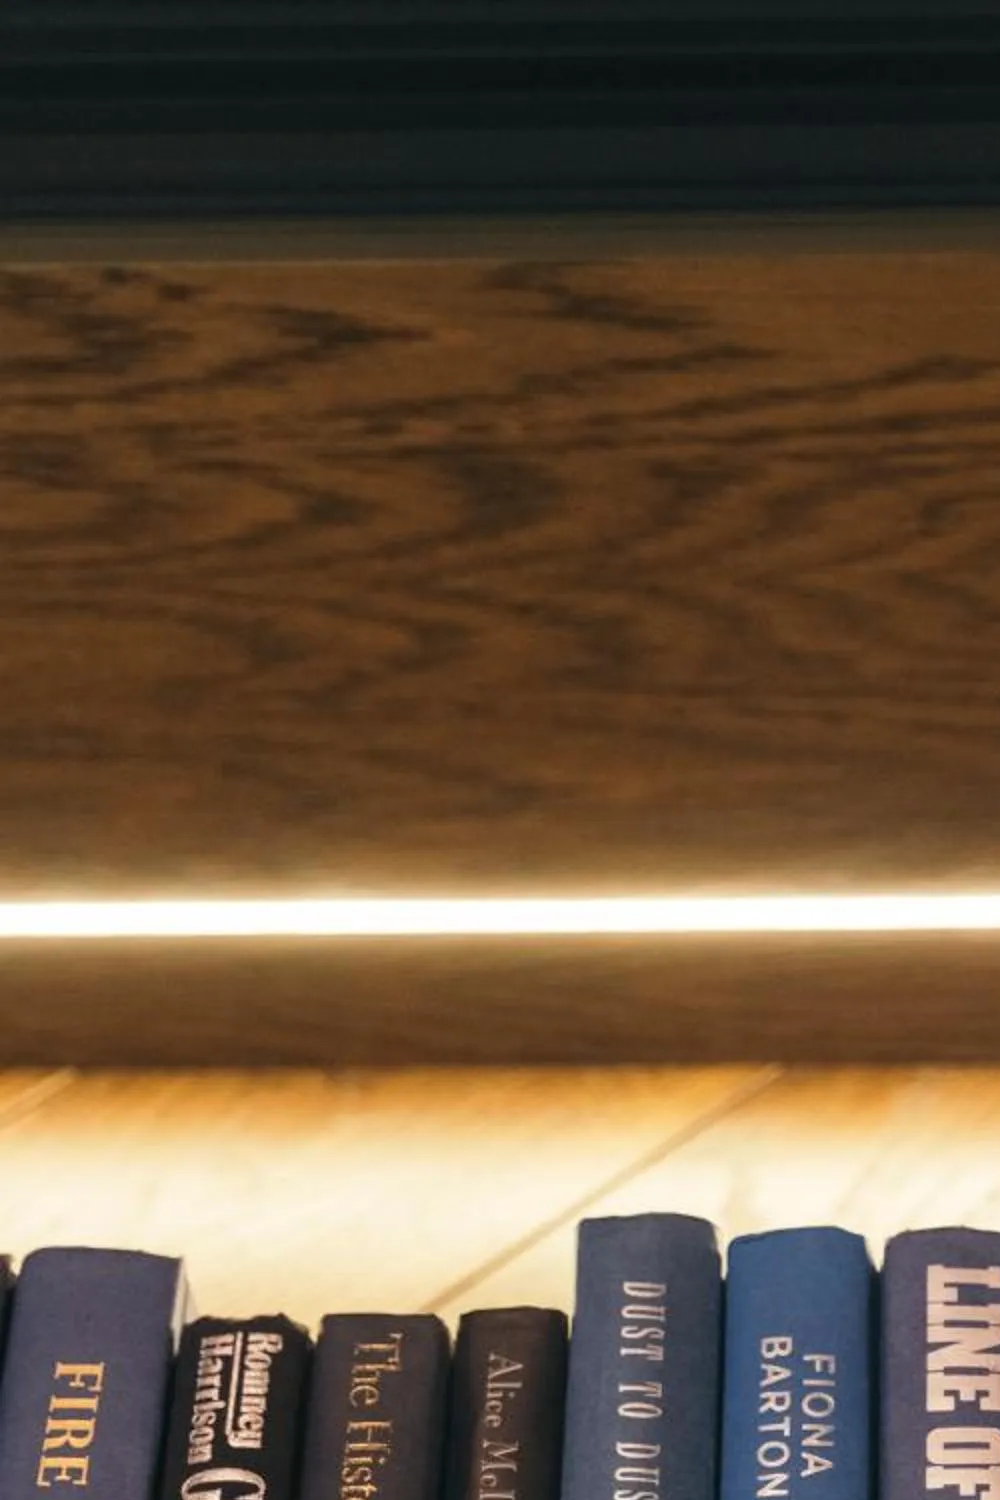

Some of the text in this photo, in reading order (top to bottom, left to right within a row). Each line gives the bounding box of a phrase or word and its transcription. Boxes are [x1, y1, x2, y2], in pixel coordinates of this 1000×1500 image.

[350, 1333, 402, 1409] The
[620, 1280, 666, 1362] DUST
[35, 1361, 105, 1487] FIRE
[187, 1333, 235, 1465] Harrison
[226, 1332, 283, 1449] Romney
[484, 1352, 524, 1428] Alice
[617, 1384, 663, 1420] TO
[756, 1335, 793, 1499] BARTON
[799, 1352, 836, 1479] FIONA
